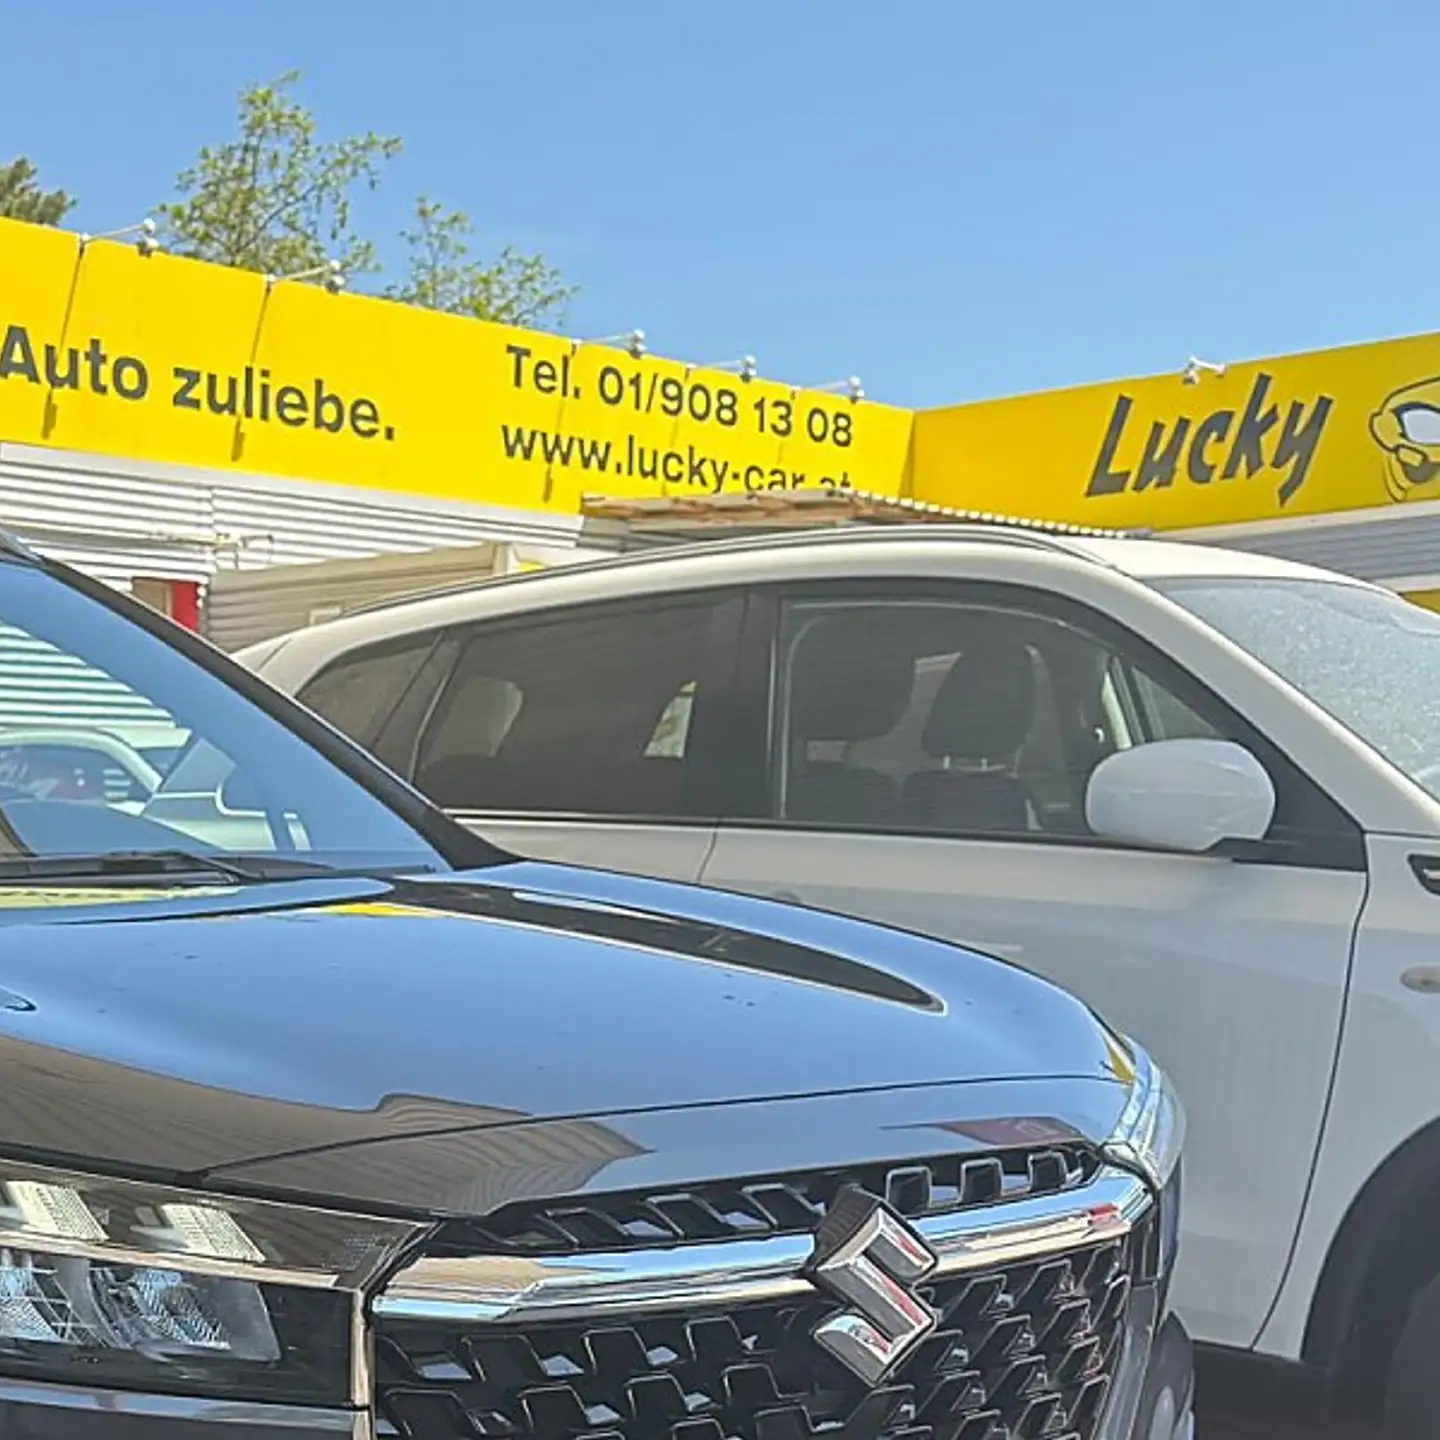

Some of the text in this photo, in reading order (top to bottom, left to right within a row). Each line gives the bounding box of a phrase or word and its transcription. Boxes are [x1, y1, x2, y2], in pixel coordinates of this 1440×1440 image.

[173, 365, 395, 441] zuliebe.
[506, 345, 852, 447] Tel. 01/908 13 08
[1085, 372, 1334, 508] Lucky
[501, 424, 852, 492] www.lucky-car
